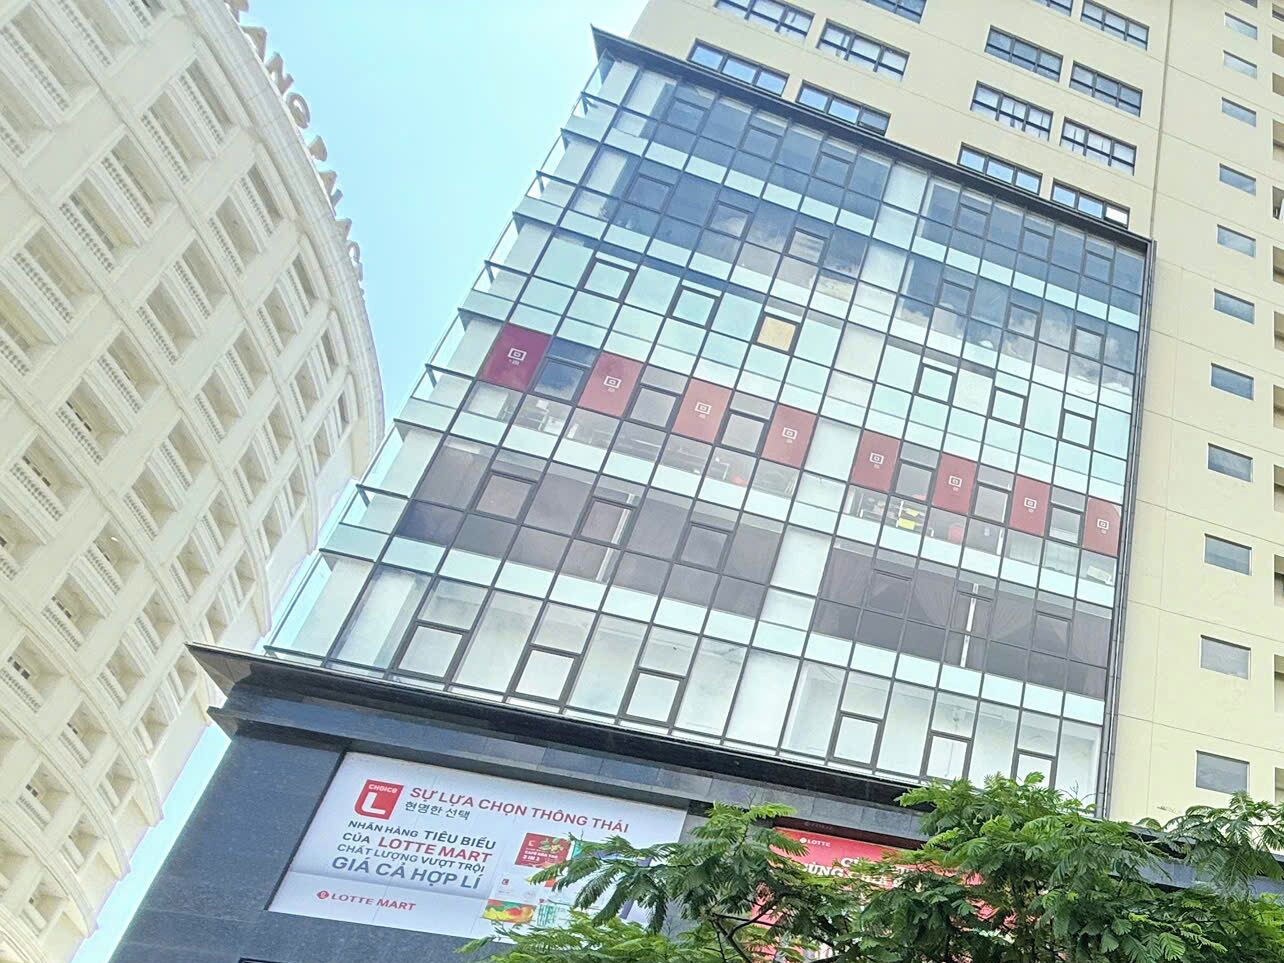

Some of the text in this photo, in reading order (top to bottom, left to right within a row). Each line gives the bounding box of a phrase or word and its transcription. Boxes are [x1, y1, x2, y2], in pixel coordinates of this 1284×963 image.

[478, 799, 527, 816] CHỌN
[531, 807, 588, 826] THÔNG
[592, 817, 629, 833] THÁI
[378, 837, 437, 855] LOTTE
[438, 846, 492, 863] MART
[806, 839, 831, 847] LOTTE
[332, 856, 371, 874] GIÁ
[410, 867, 458, 886] HỢP
[460, 873, 485, 889] LÍ
[331, 892, 416, 911] LOTTE MART
